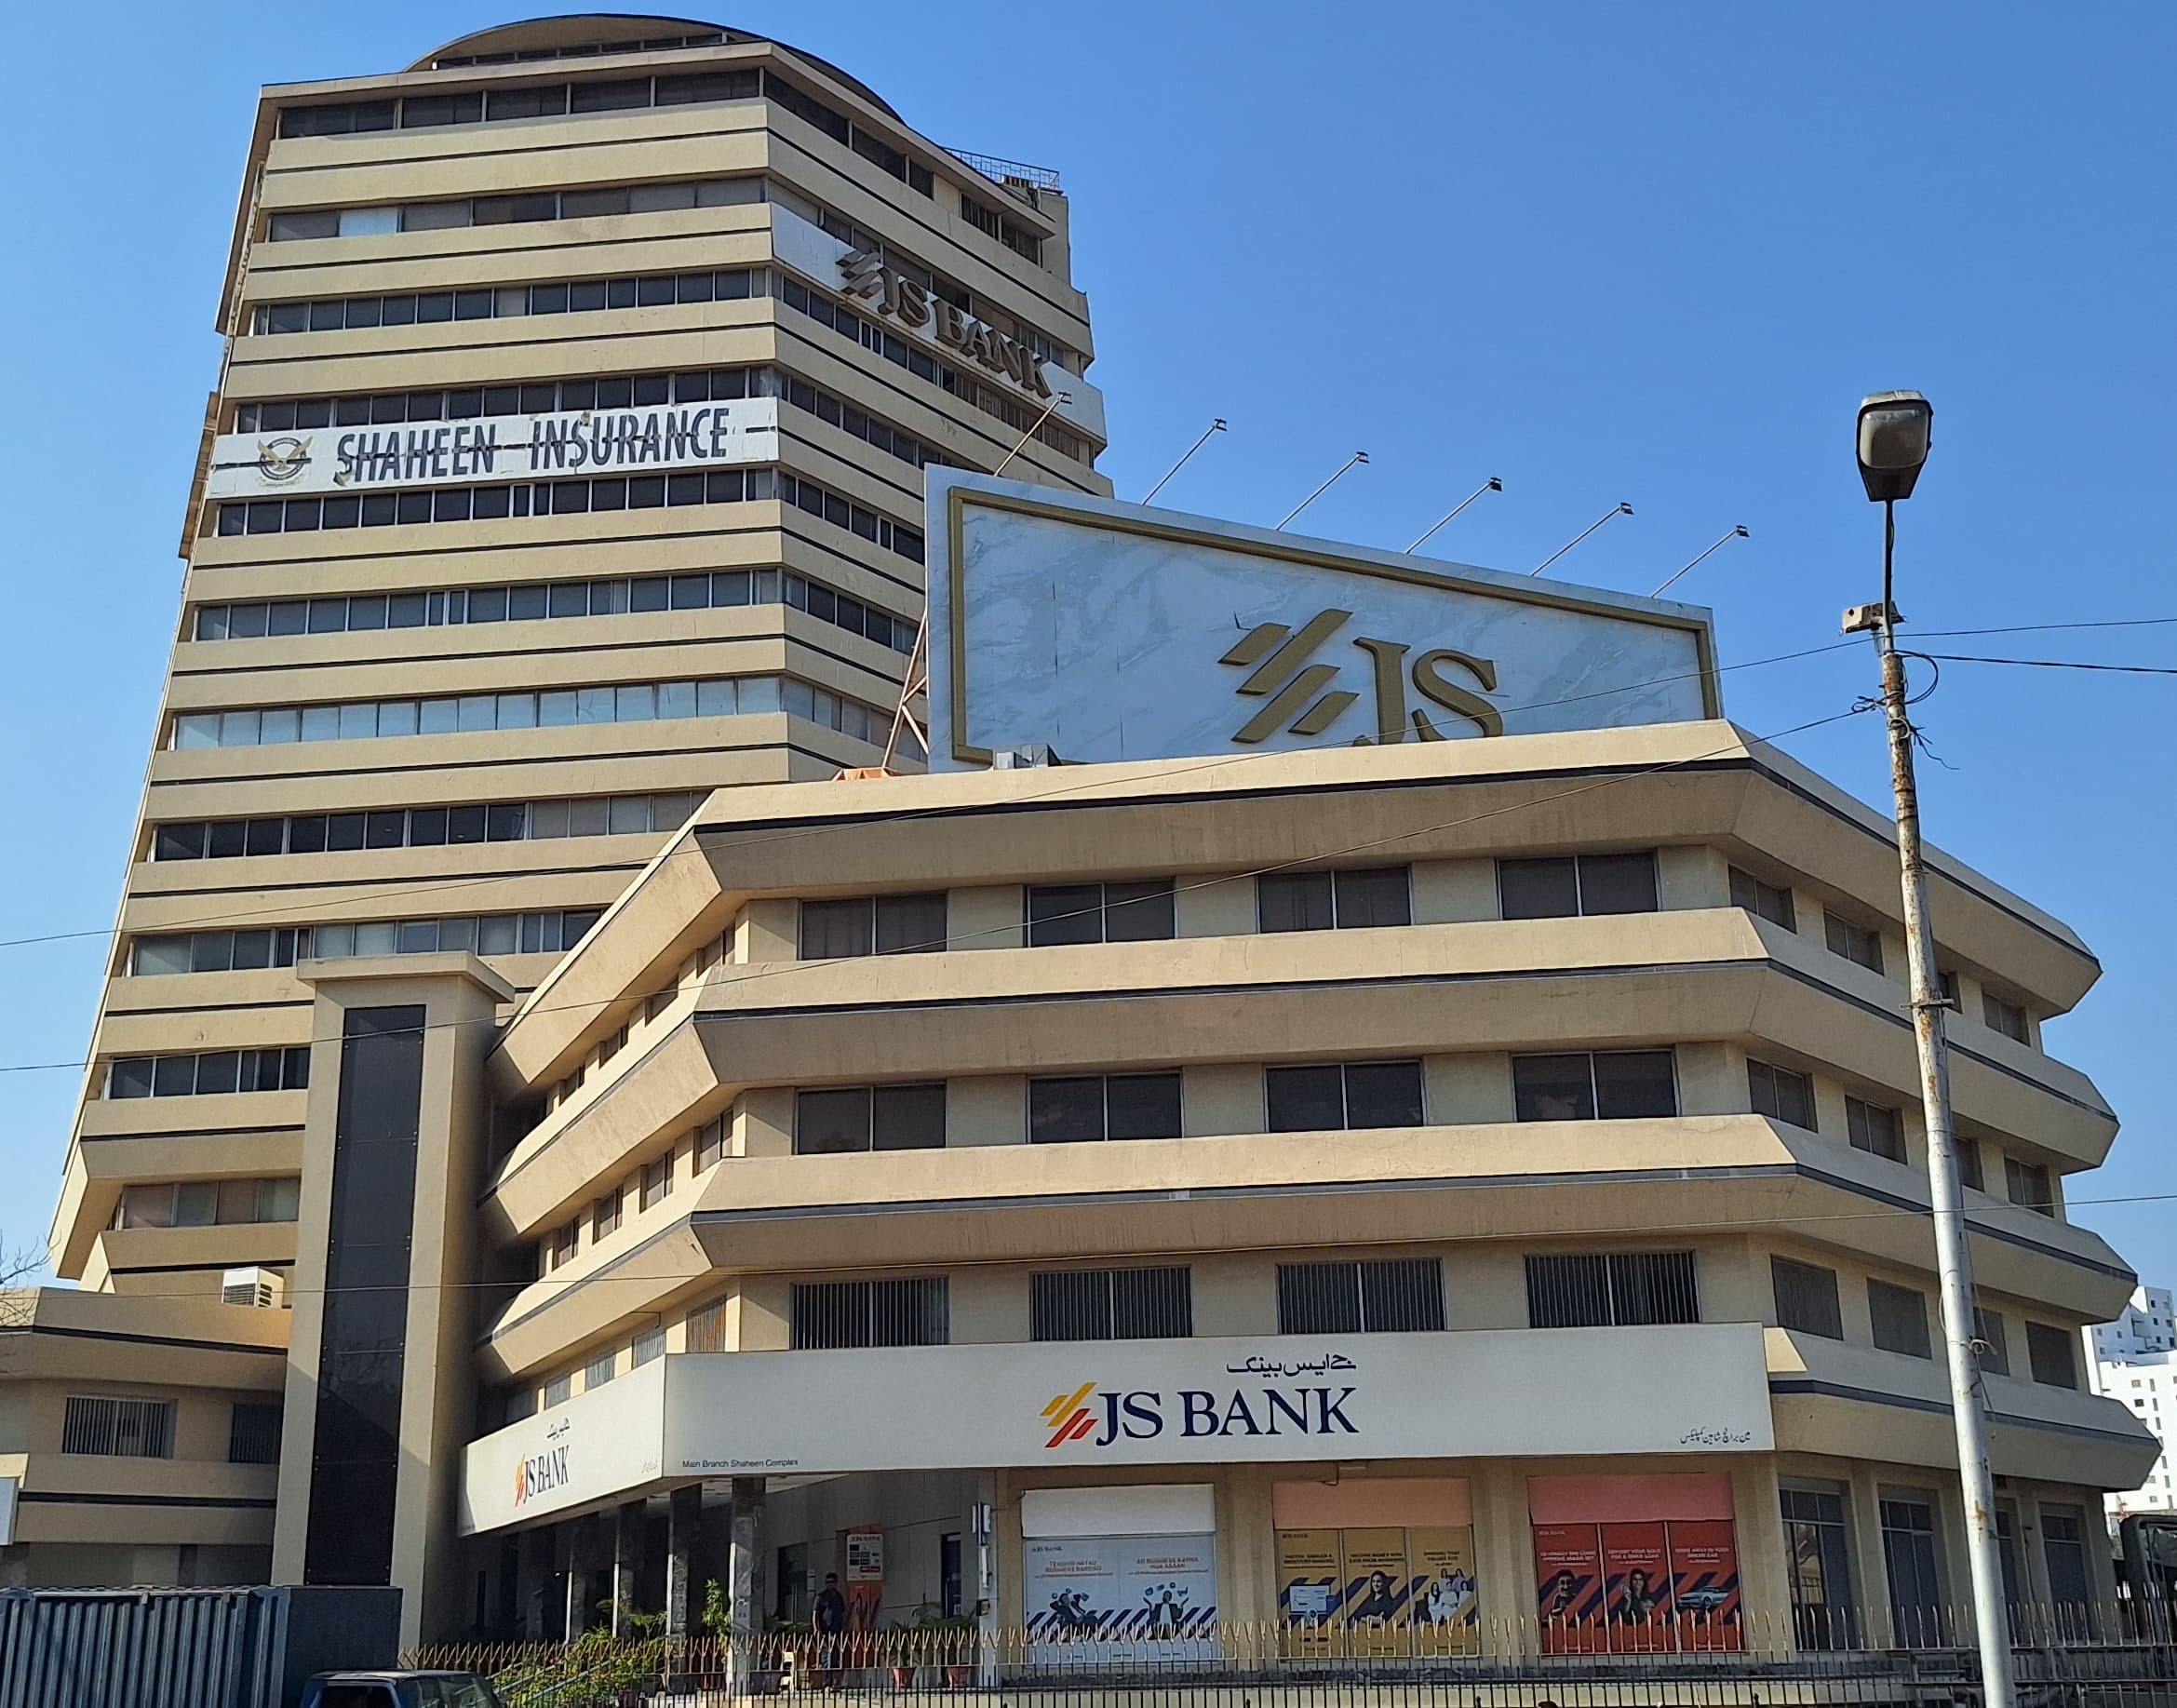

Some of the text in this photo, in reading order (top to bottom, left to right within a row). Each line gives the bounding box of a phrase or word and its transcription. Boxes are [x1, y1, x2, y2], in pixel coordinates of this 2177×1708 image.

[877, 265, 1053, 399] JS BANK
[334, 407, 730, 488] SHAHEEN INSURANCE
[1352, 636, 1504, 746] JS
[1095, 1387, 1360, 1446] JS BANK
[523, 1445, 571, 1504] JS BANK
[682, 1459, 701, 1468] Main
[703, 1459, 729, 1468] Branch
[731, 1459, 764, 1468] Shaheen
